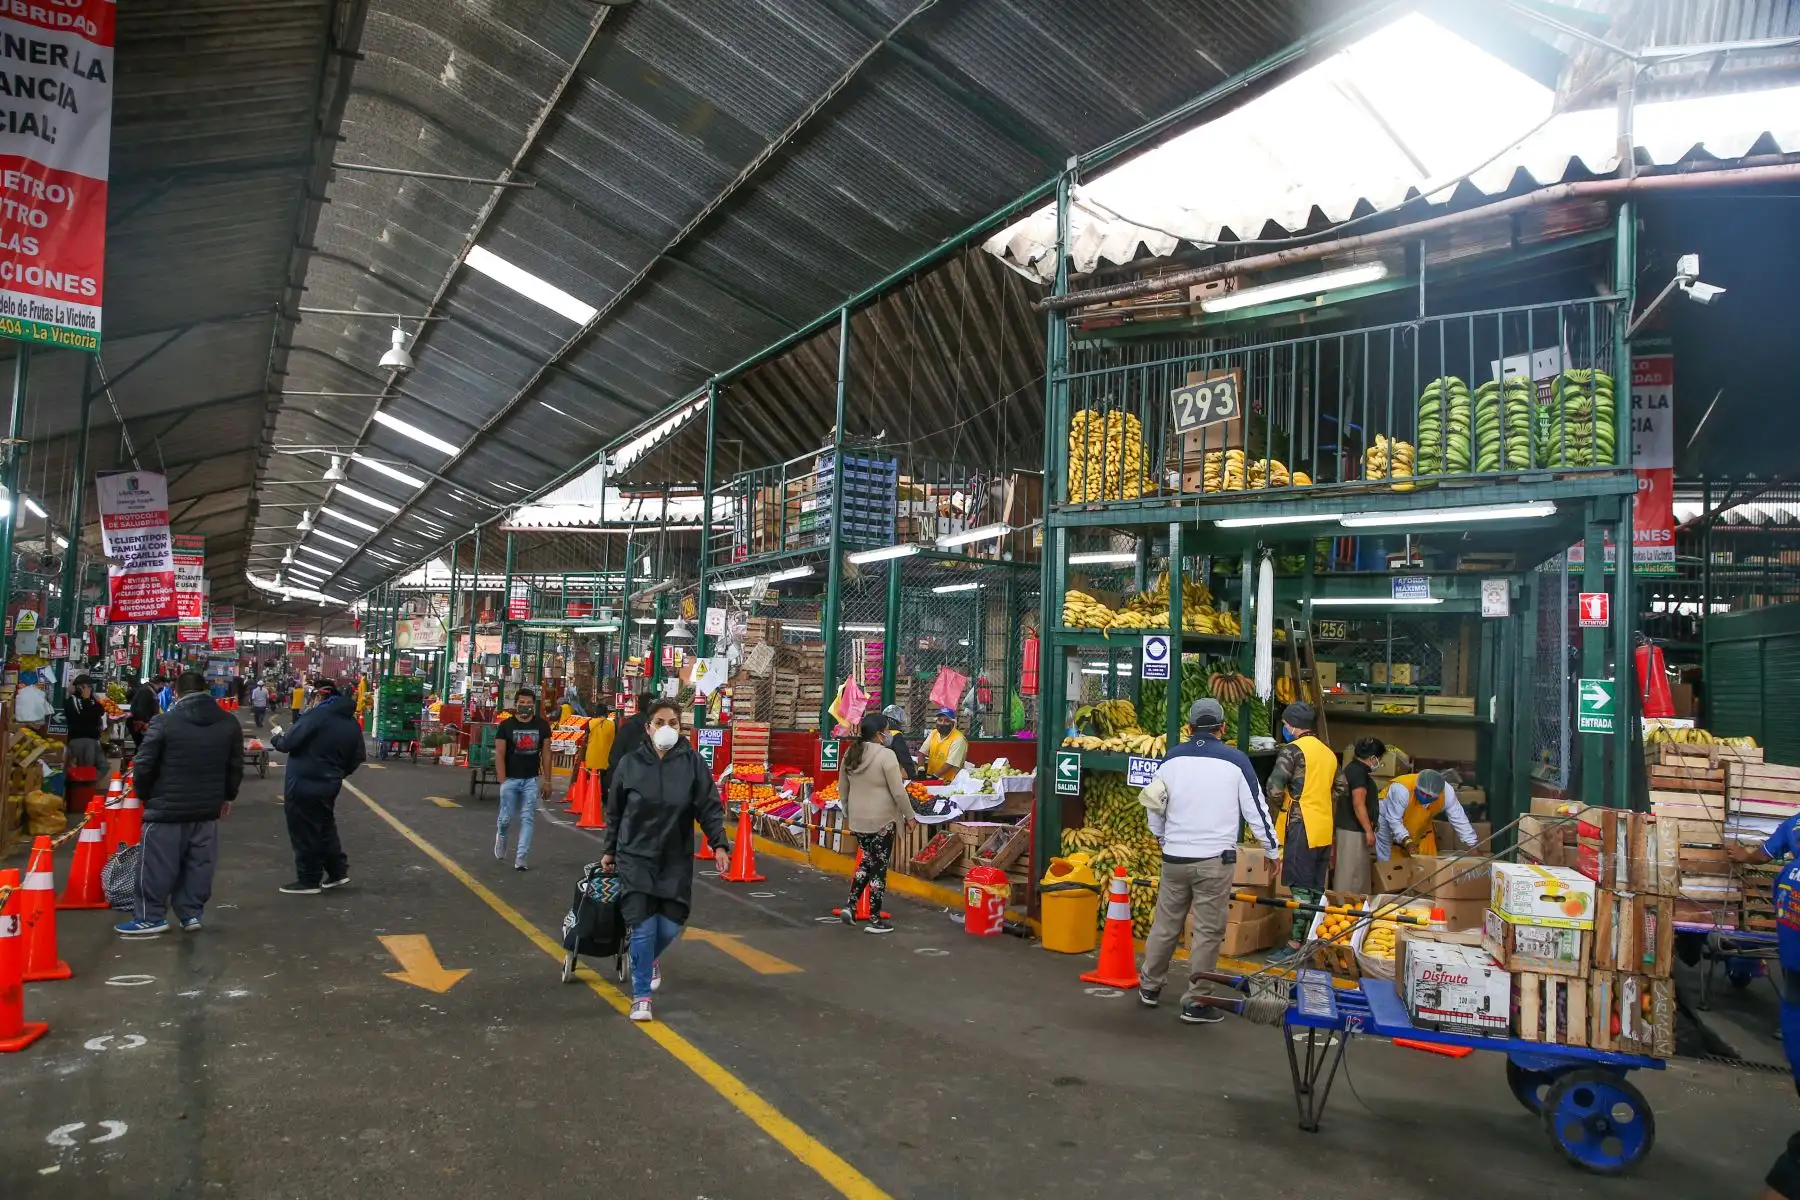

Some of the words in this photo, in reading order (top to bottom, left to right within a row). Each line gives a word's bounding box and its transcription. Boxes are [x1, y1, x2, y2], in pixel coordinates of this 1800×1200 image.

[0, 29, 69, 70] NER
[73, 50, 107, 83] LA
[0, 169, 75, 211] ETRO)
[0, 197, 49, 229] TRO
[1, 260, 97, 297] CIONES
[17, 300, 28, 319] de
[29, 301, 54, 323] Frutas
[55, 304, 66, 325] La
[66, 306, 96, 330] Victoria
[32, 323, 48, 340] La
[51, 326, 97, 349] Victoria
[1178, 382, 1234, 427] 293
[1648, 394, 1669, 410] LA
[152, 533, 168, 542] POR
[148, 542, 167, 550] CON
[1645, 563, 1675, 572] Victoria
[1321, 622, 1344, 638] 256
[1581, 717, 1613, 729] ENTRADA
[700, 730, 721, 738] AFORO
[1131, 759, 1159, 774] AFOR
[1057, 783, 1077, 791] SALIDA
[1422, 969, 1469, 984] Disfruta
